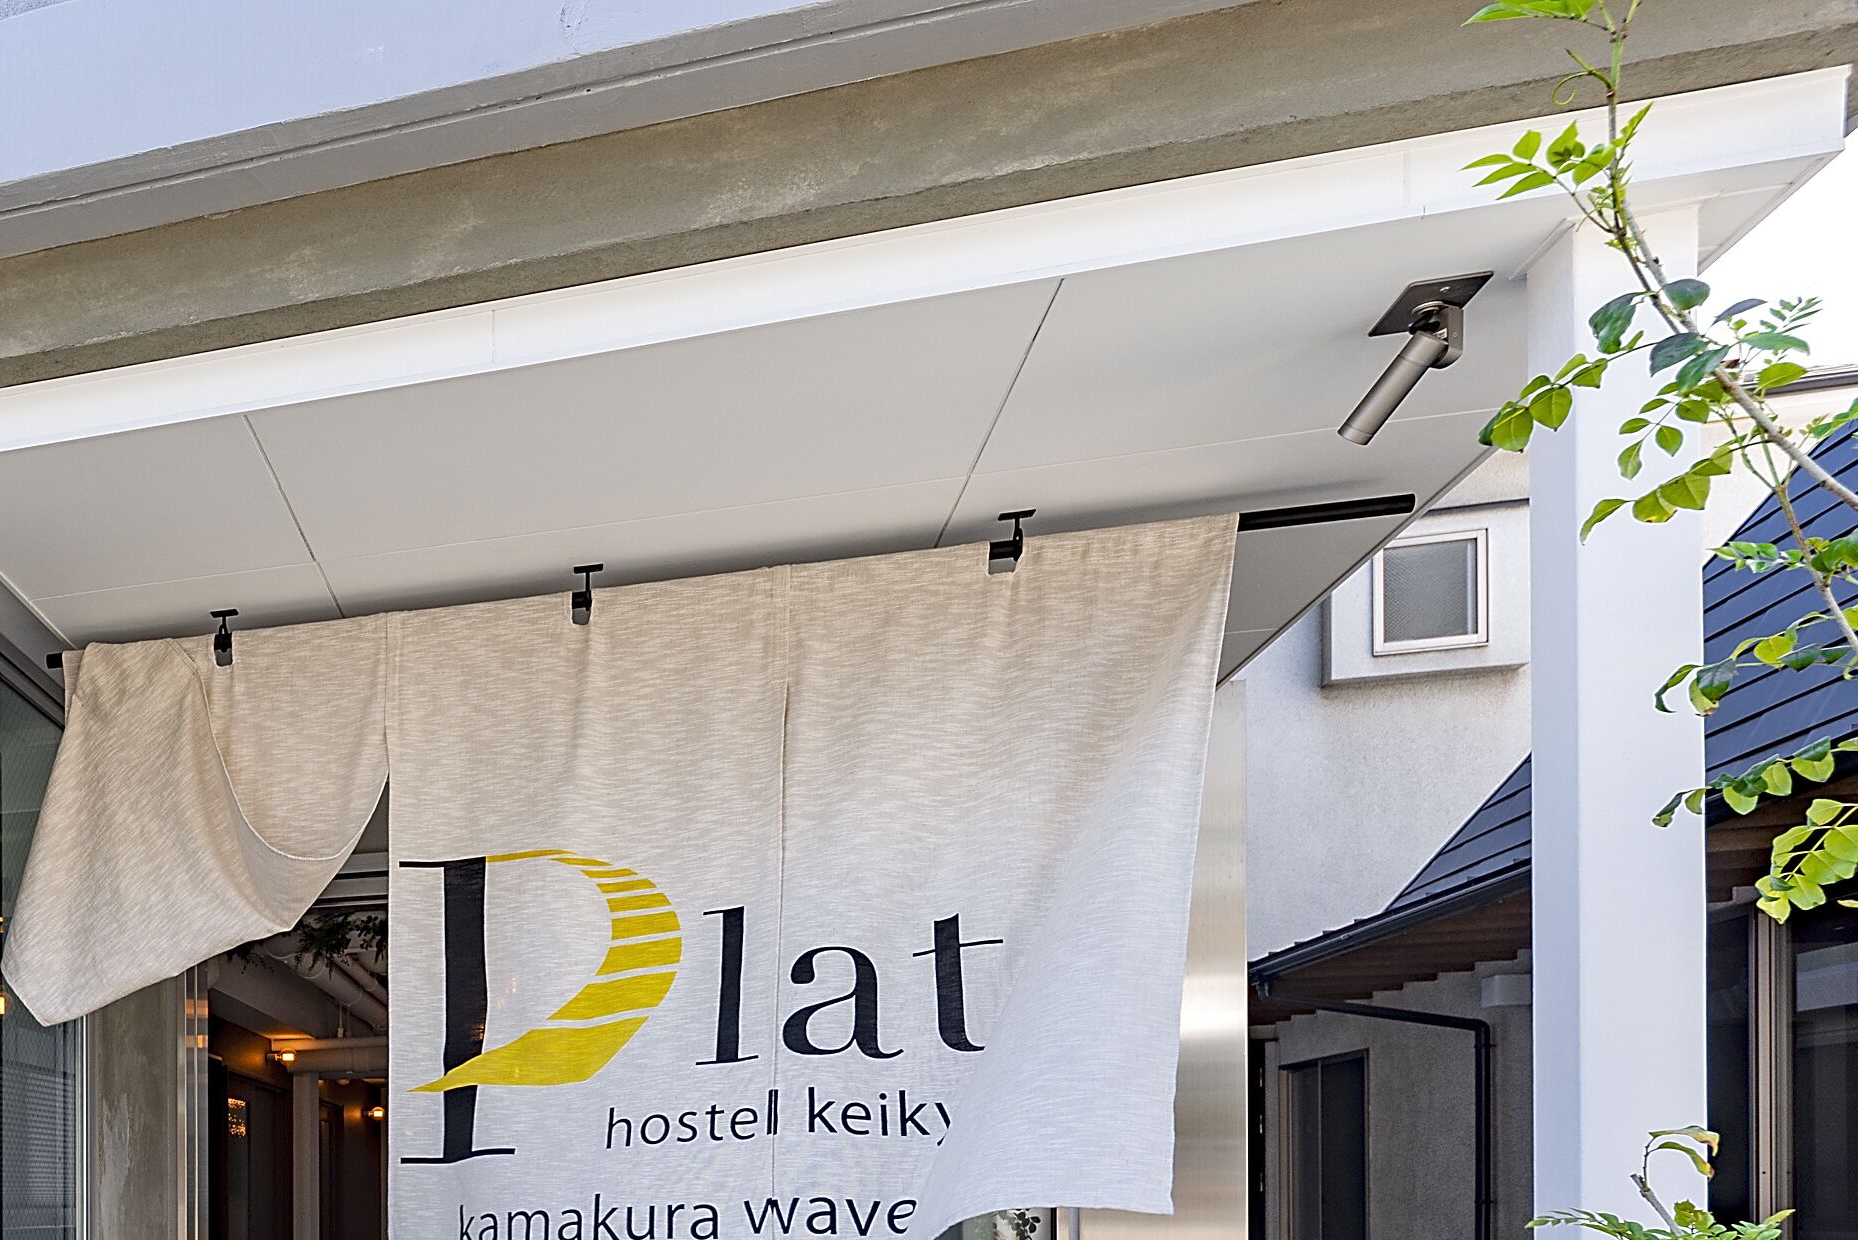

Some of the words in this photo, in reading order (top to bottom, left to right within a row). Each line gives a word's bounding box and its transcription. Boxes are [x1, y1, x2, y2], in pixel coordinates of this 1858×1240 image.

[398, 849, 1004, 1165] Plat
[606, 1089, 779, 1149] hostel
[743, 1197, 917, 1237] wave
